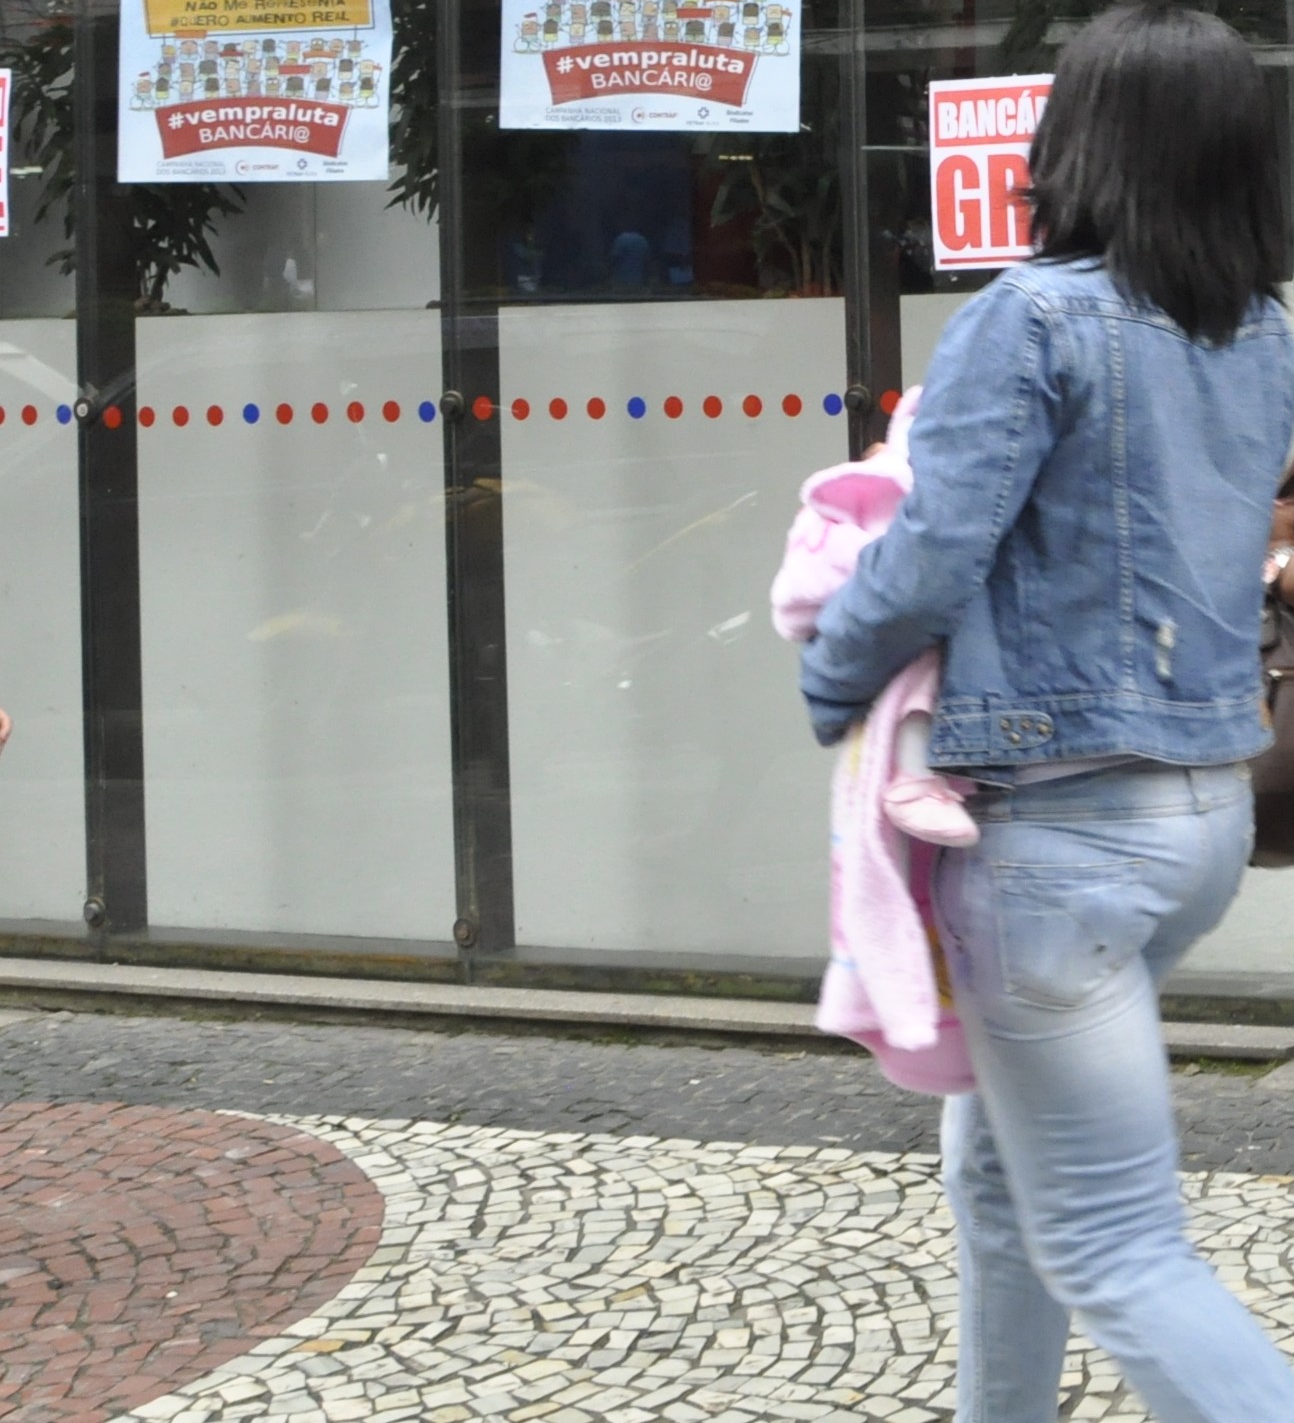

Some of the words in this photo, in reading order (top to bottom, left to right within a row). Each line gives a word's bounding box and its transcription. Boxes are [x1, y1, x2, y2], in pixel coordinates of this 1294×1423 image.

[236, 13, 306, 26] AUMENTO
[312, 11, 350, 23] REAL
[556, 49, 744, 75] #vempraluta
[591, 67, 712, 91] BANCÁRI@
[168, 104, 339, 130] #vempraluta
[199, 121, 310, 145] BANCÁRI@
